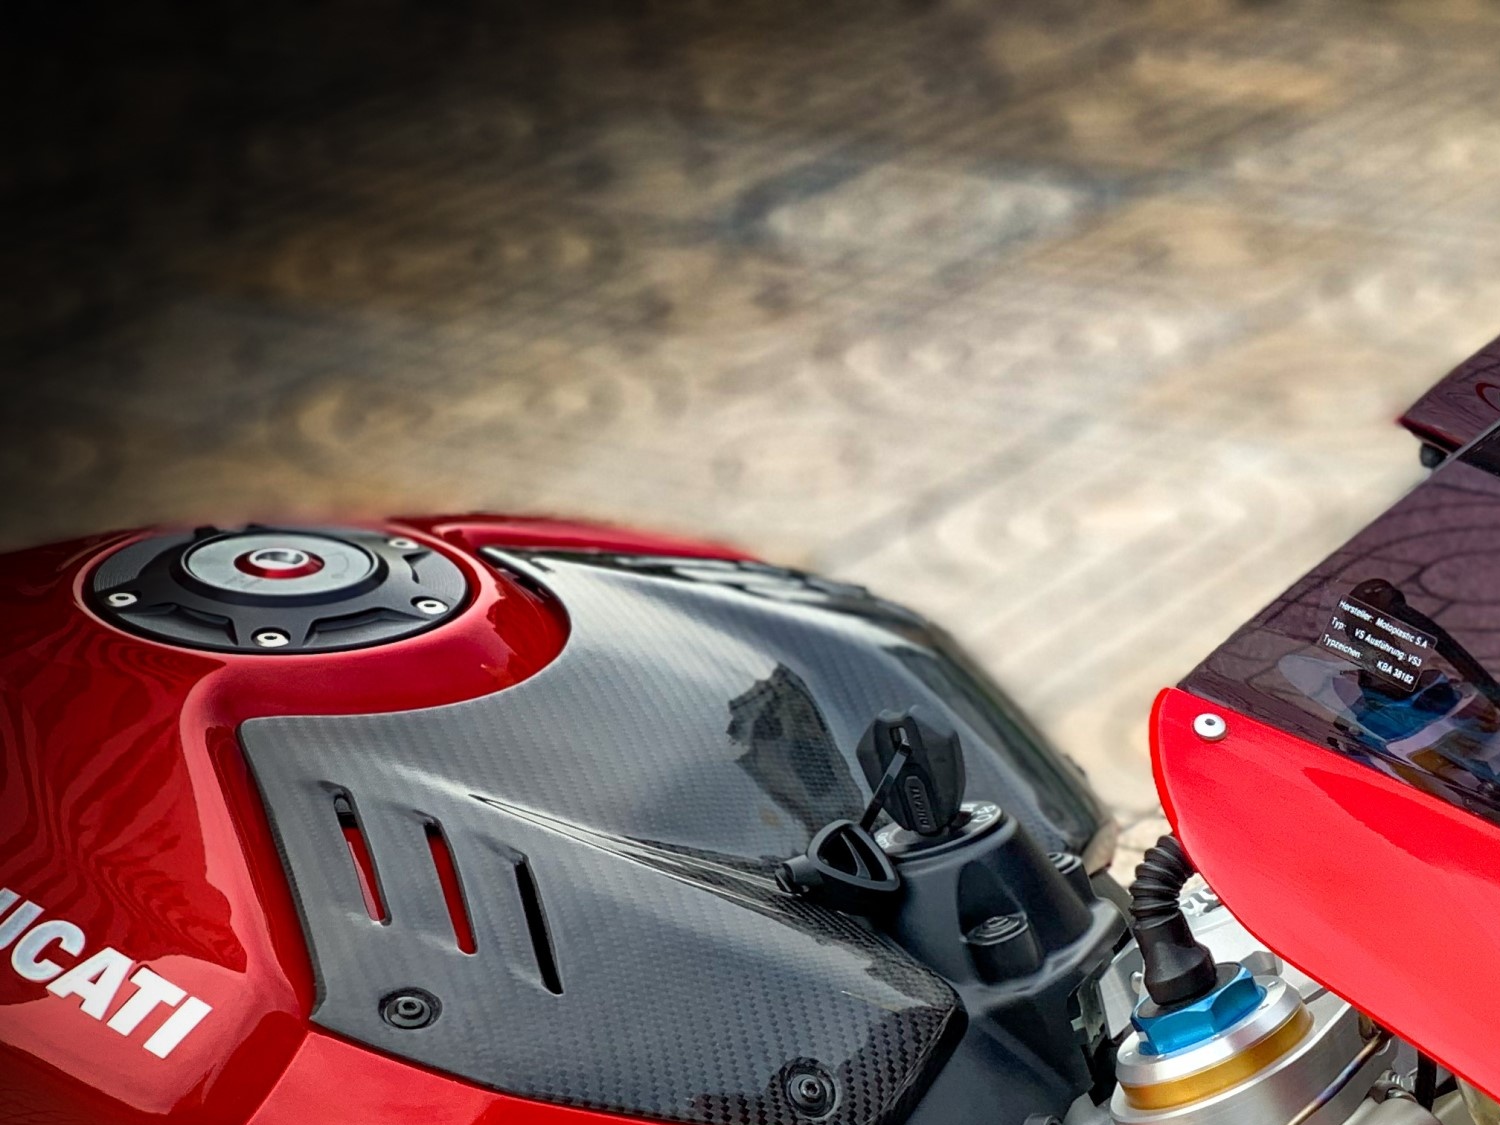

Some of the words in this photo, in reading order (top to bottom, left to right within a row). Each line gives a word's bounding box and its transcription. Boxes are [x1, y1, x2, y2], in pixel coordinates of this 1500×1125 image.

[1331, 616, 1347, 631] Typ:
[1354, 628, 1366, 640] VS
[1407, 654, 1423, 667] VS3
[1376, 660, 1393, 675] KBA
